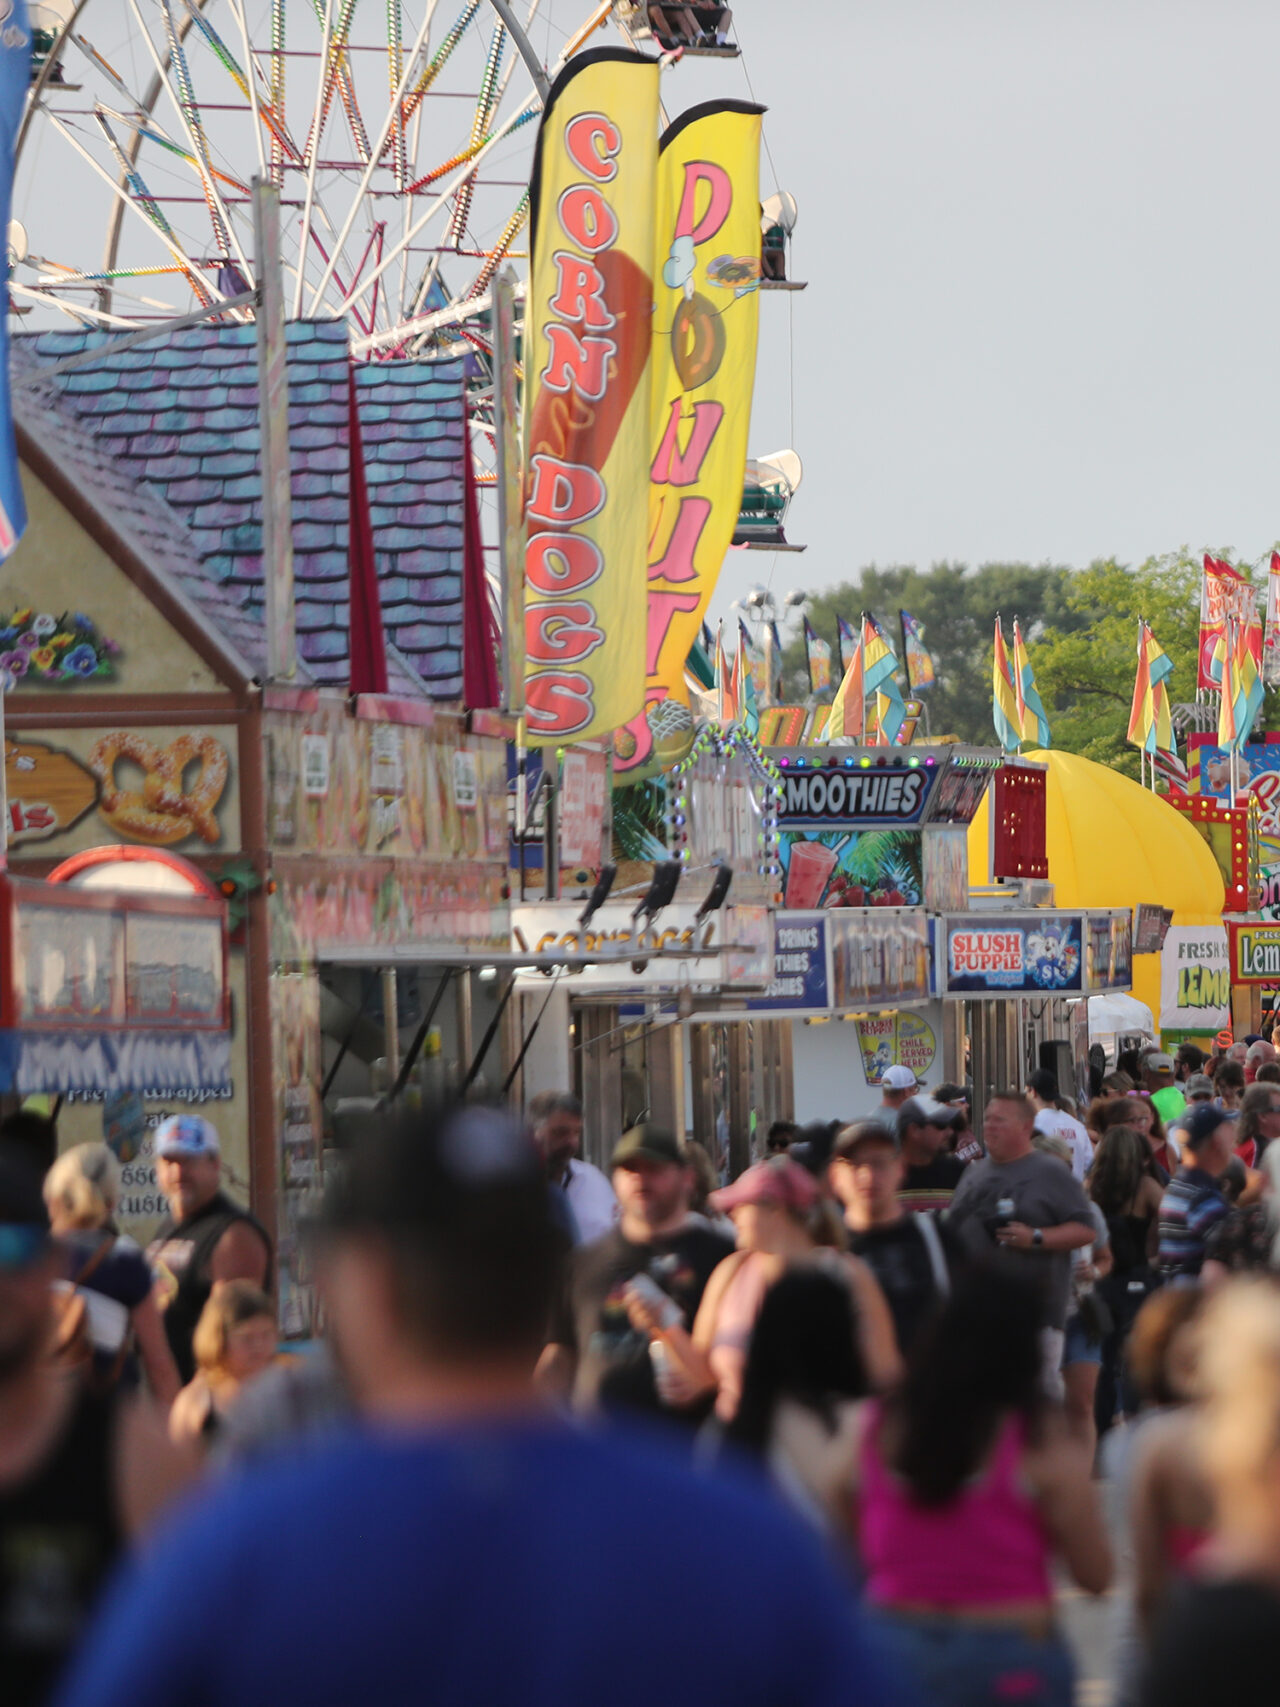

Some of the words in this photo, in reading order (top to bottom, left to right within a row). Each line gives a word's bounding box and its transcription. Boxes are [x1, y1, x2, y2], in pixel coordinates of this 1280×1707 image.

[541, 110, 622, 401] CORN
[525, 453, 606, 738] DOGS
[775, 772, 924, 816] SMOOTHIES
[953, 934, 1021, 953] SLUSH
[1178, 942, 1220, 959] FRESH
